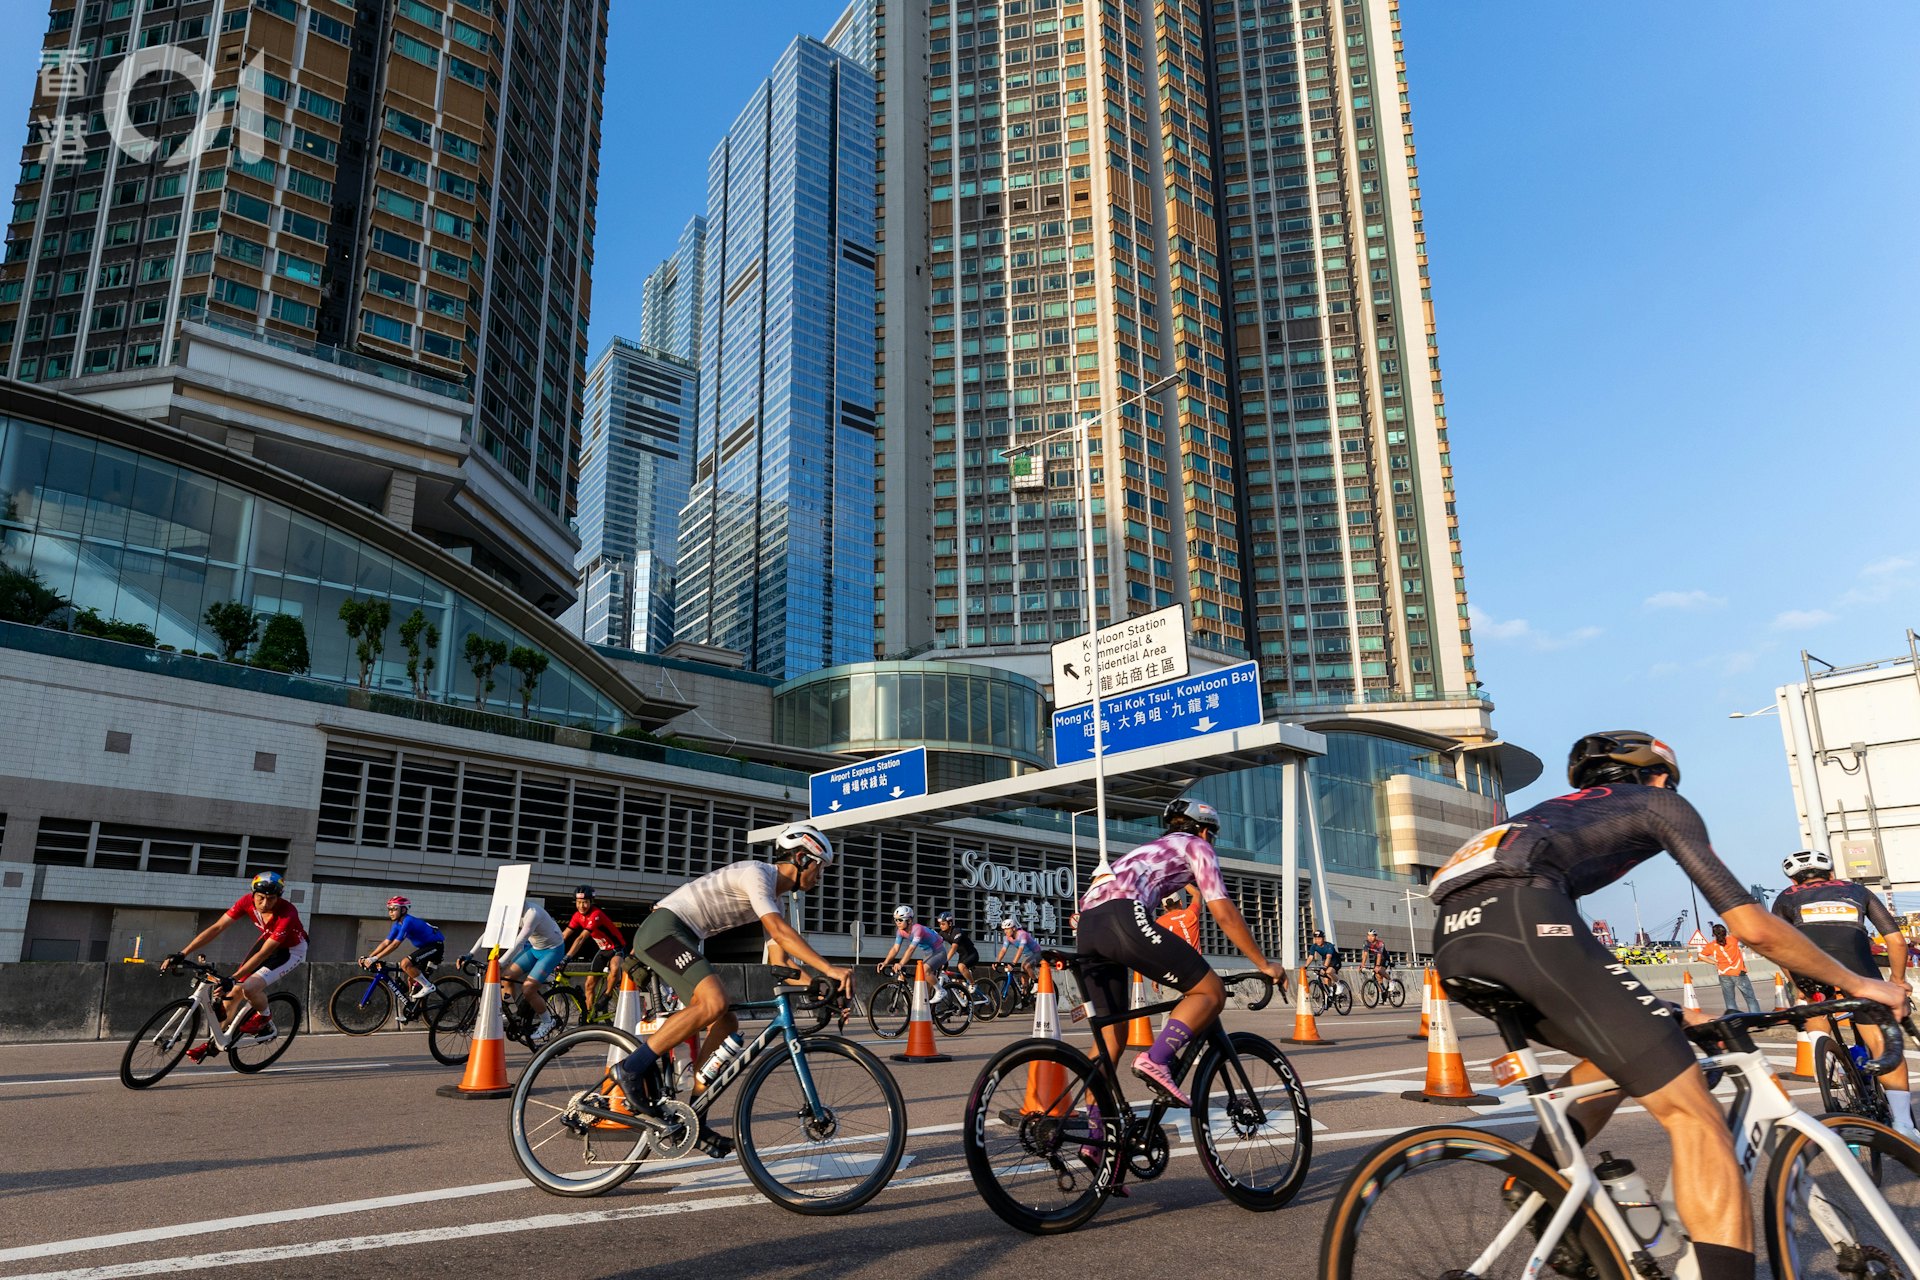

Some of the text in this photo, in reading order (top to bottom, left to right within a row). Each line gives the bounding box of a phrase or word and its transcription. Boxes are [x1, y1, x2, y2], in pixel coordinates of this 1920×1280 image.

[1083, 635, 1153, 662] Cmmercial &
[1128, 617, 1166, 635] Station
[1084, 646, 1166, 675] Rsidential Area
[1056, 669, 1255, 727] Mong Ko, Tai Kok Tsui, Kowloon Bay
[830, 759, 900, 783] Airport Express Station
[961, 850, 1074, 898] SORRENTO
[1605, 963, 1670, 1017] MAAP
[691, 1033, 766, 1114] SCOTT
[1272, 1058, 1308, 1117] roval
[975, 1070, 1000, 1148] roval
[1202, 1123, 1238, 1188] roval
